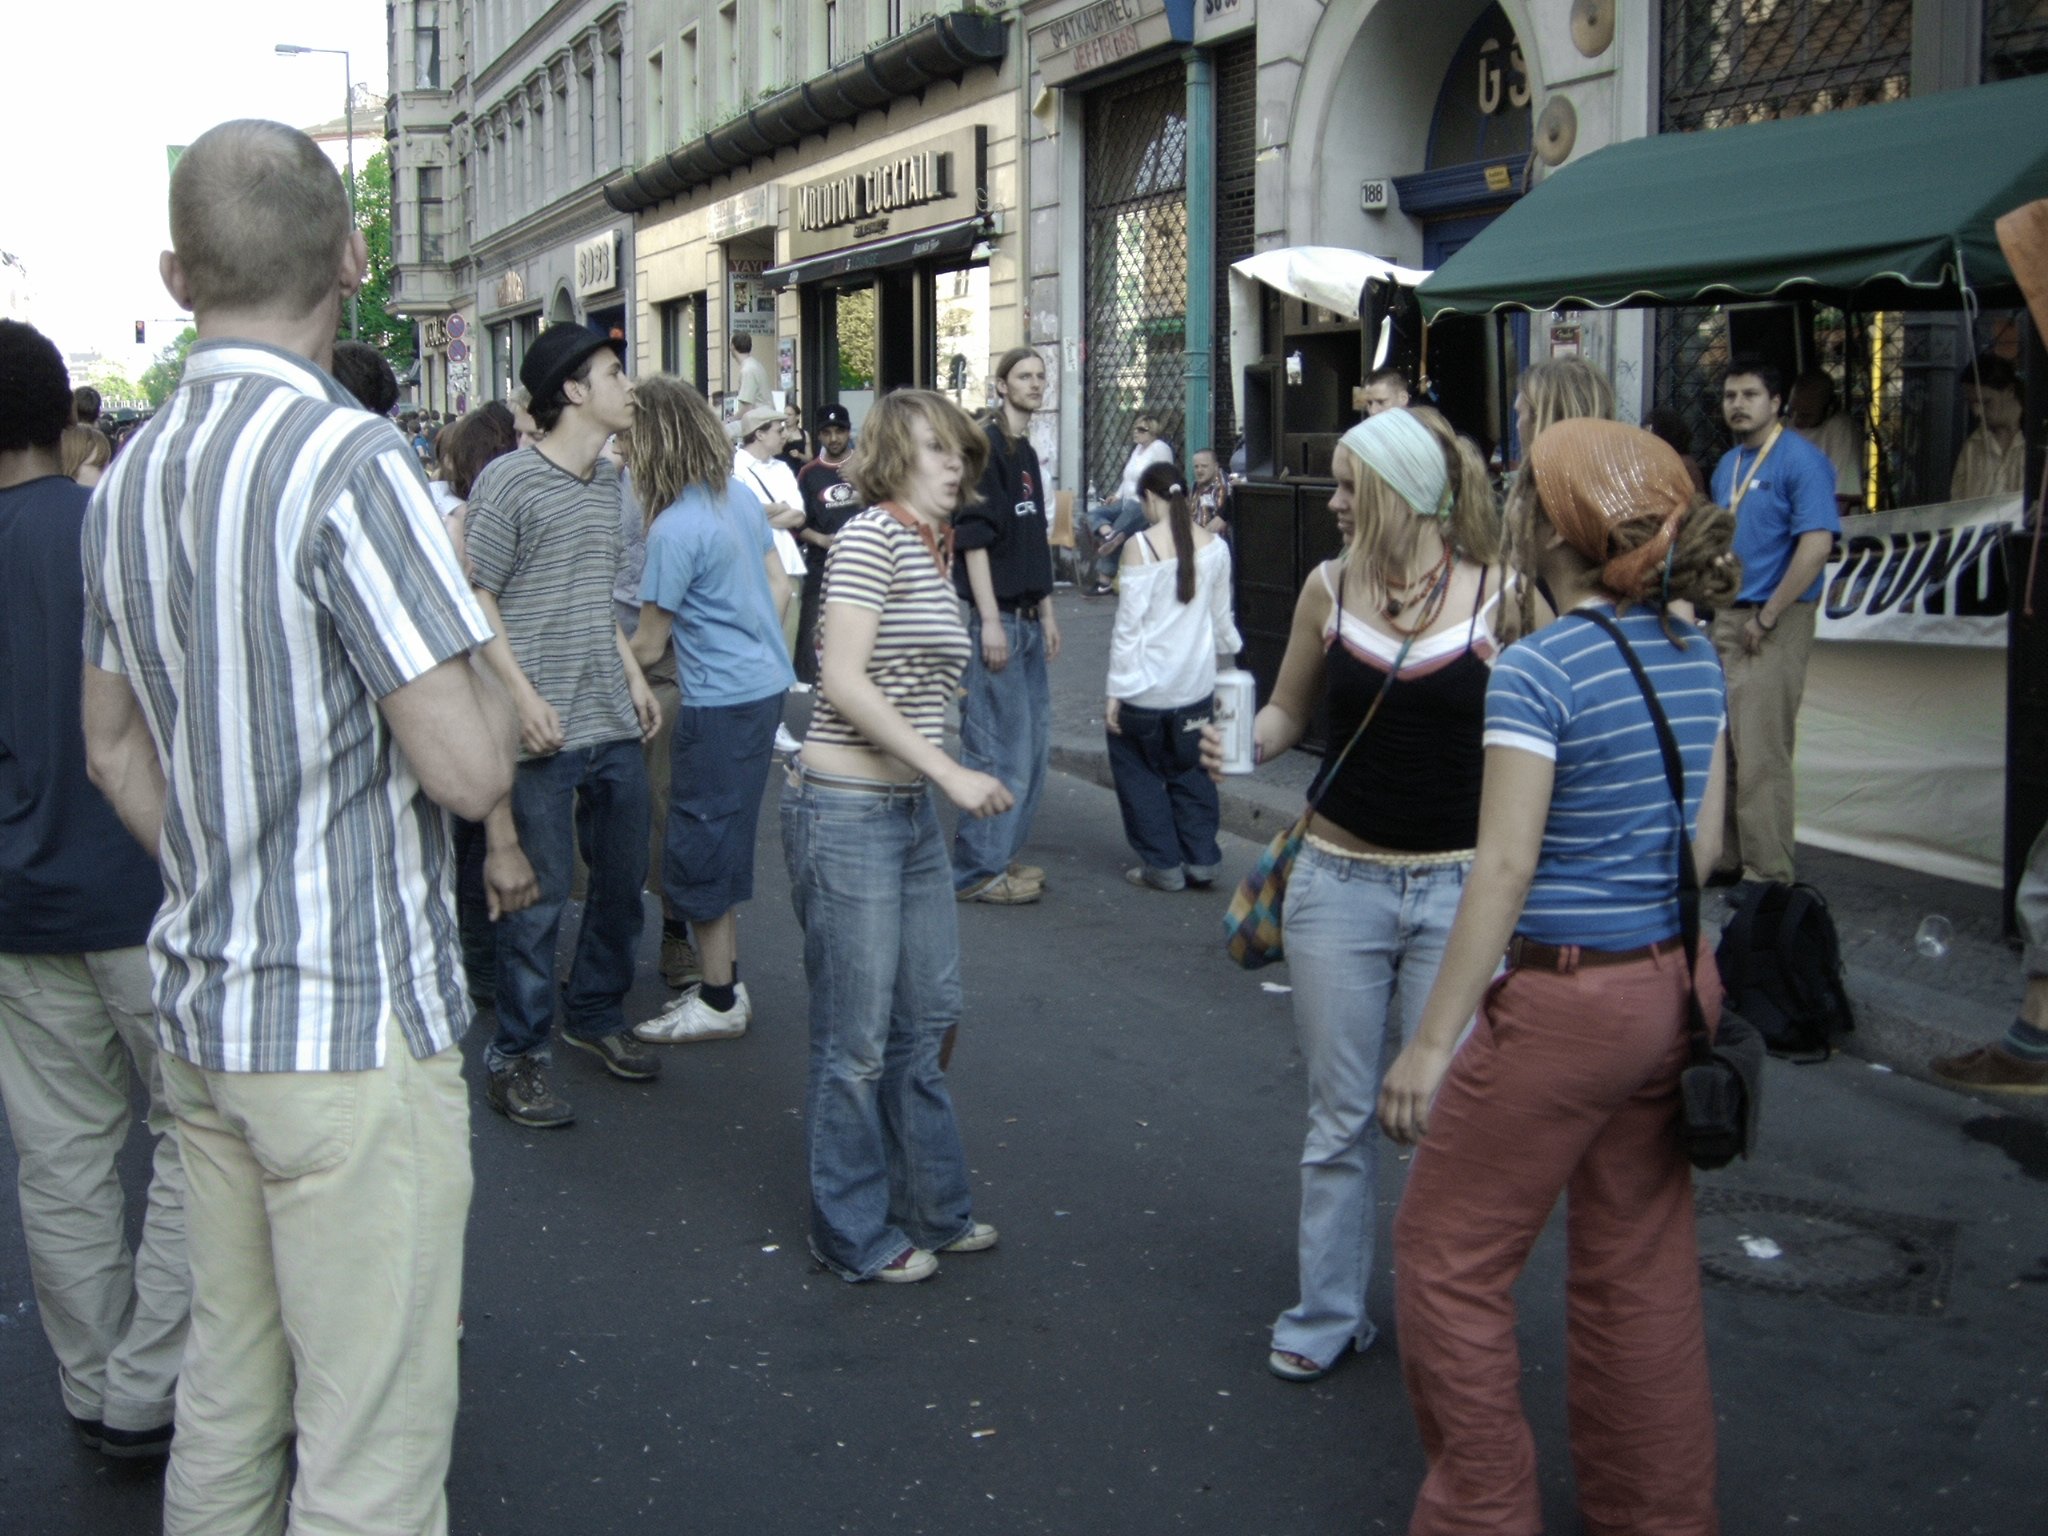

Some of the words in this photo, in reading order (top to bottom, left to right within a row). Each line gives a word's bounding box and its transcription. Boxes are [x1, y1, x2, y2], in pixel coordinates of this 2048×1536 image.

[798, 173, 858, 232] MOLOTOW
[865, 150, 942, 214] COCKTAIL
[1361, 183, 1383, 204] 188
